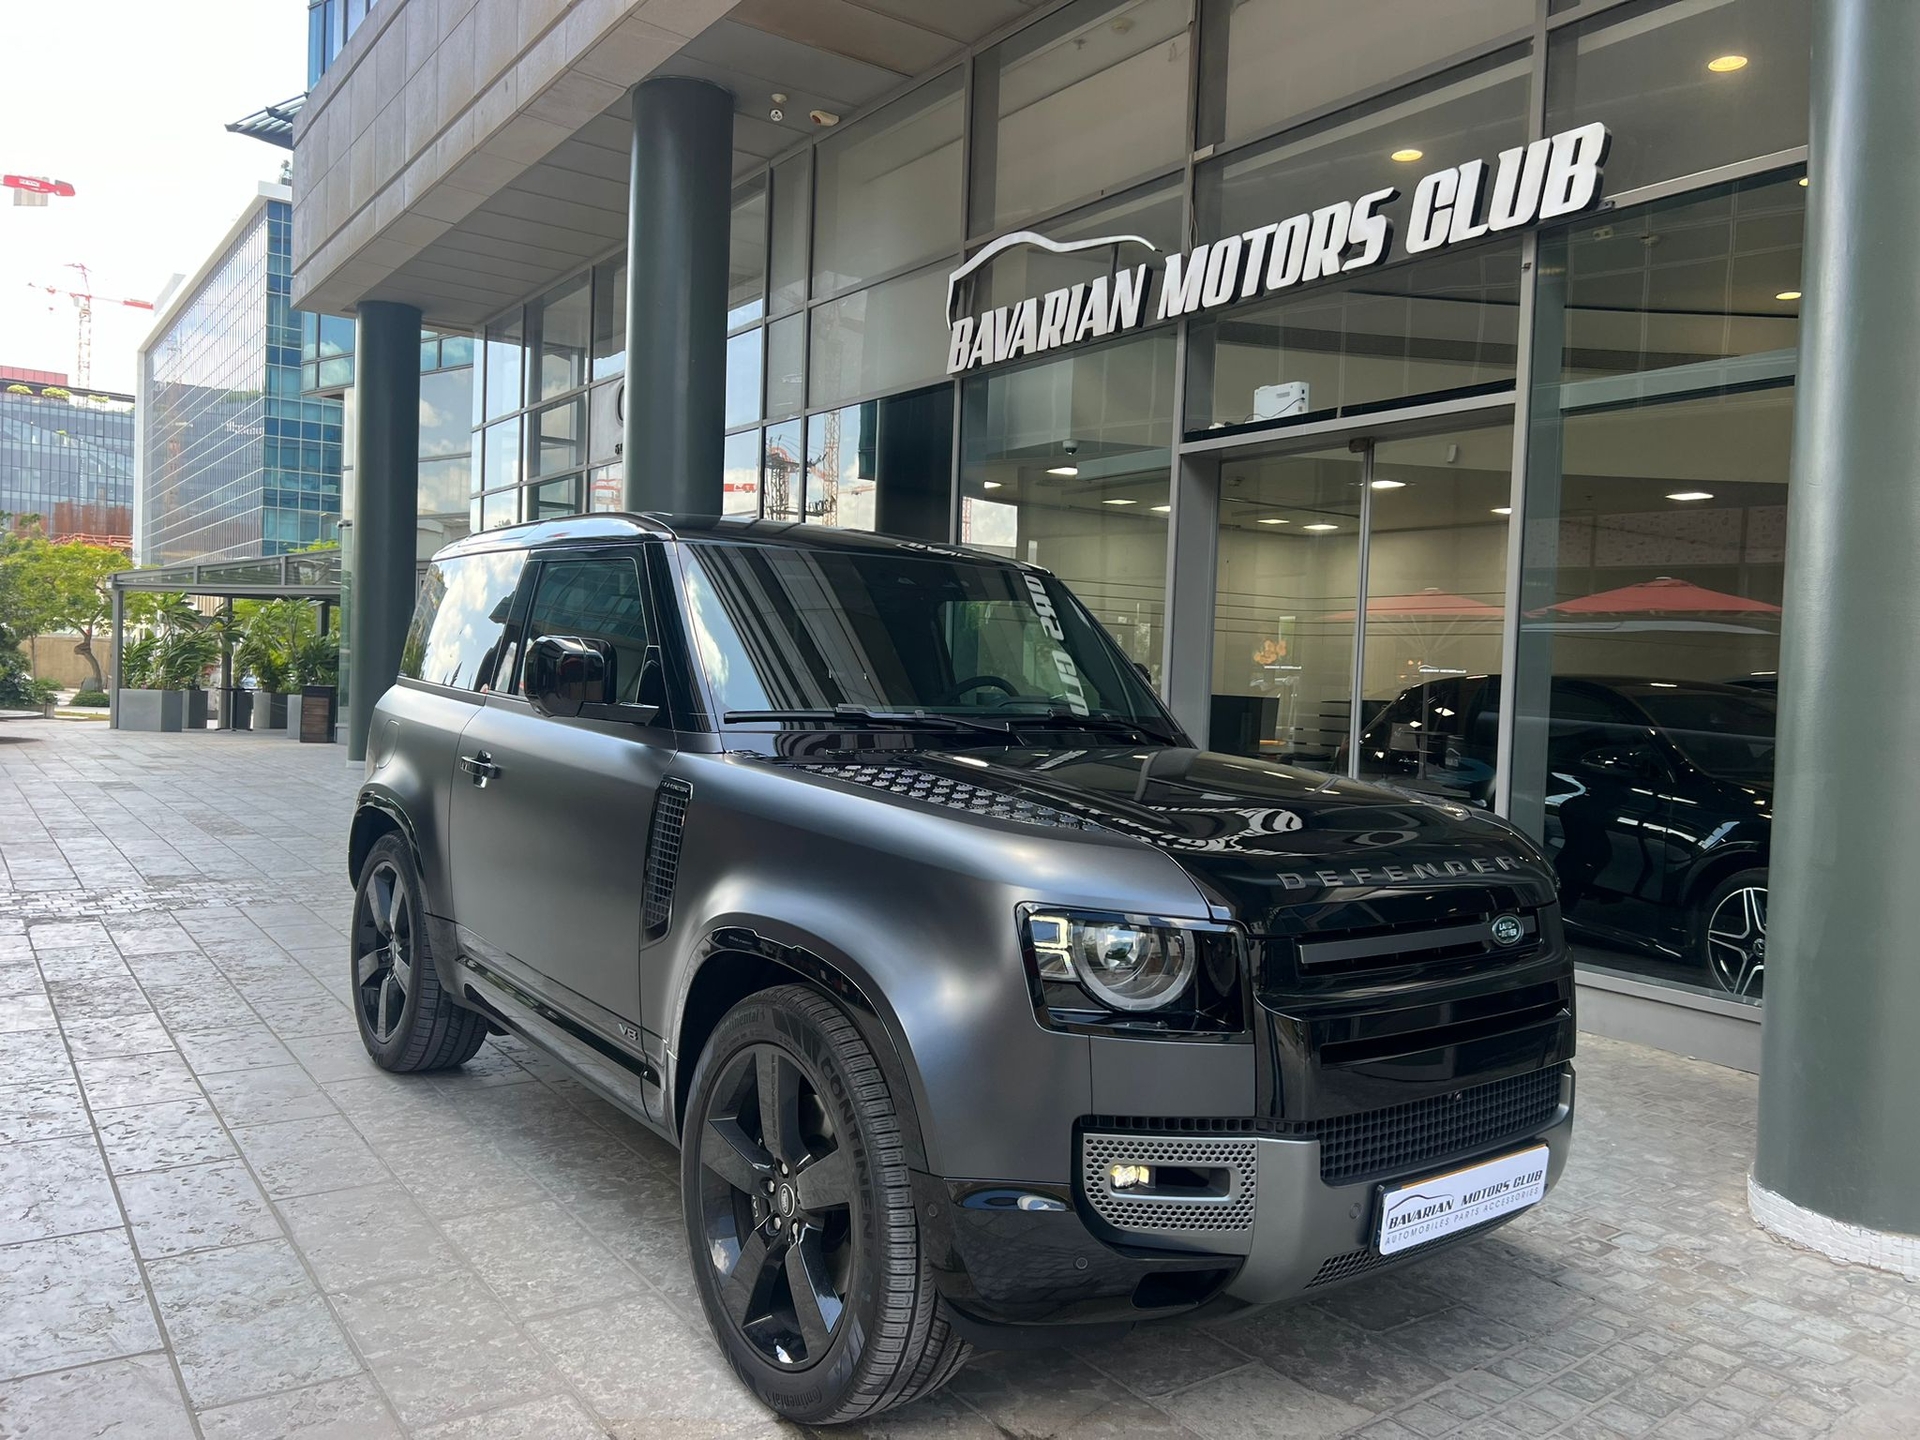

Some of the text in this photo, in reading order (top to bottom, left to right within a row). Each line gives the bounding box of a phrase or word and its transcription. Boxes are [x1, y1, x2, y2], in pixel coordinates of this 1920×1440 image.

[947, 122, 1608, 375] BAVARIAN MOTORS CLUB
[1276, 855, 1522, 891] DEFENDER
[618, 1022, 639, 1041] V8
[1384, 1186, 1539, 1246] AUTOMOBILES PARTS ACCESSORIES
[1388, 1170, 1543, 1230] BAVARIAN MOTORS CLUB
